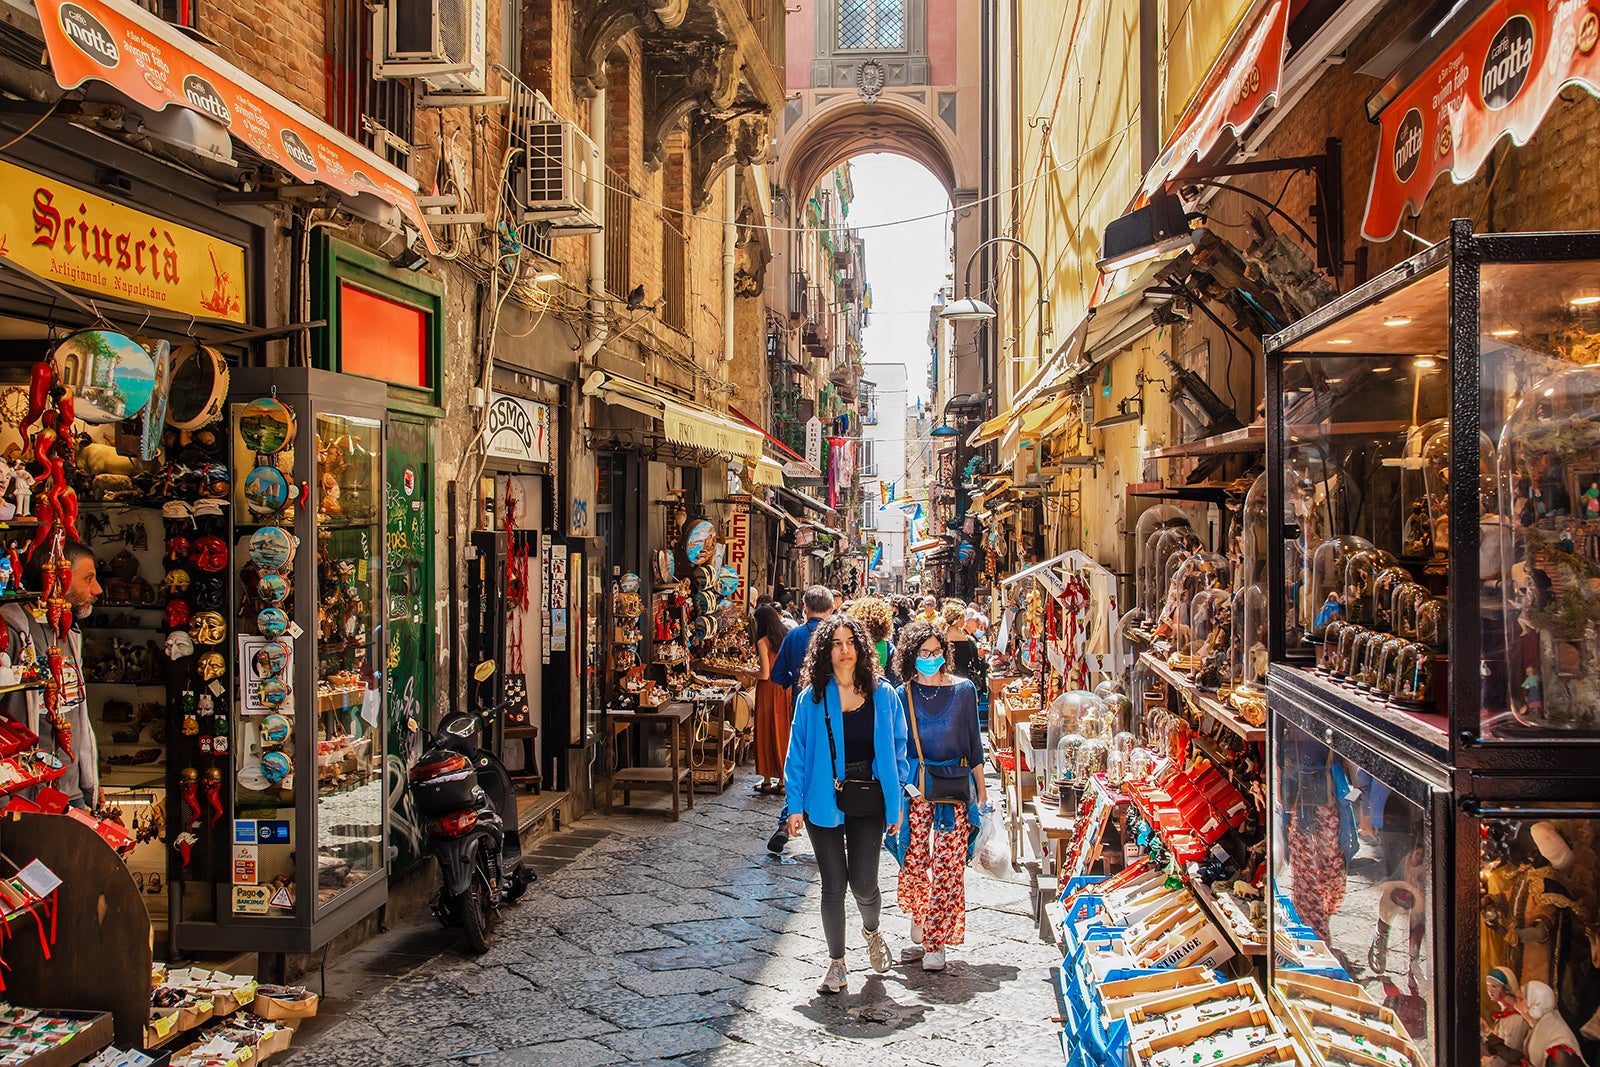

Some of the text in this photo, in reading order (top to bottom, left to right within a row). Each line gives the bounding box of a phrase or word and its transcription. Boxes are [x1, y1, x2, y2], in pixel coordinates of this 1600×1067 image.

[65, 17, 118, 60] motta
[1483, 36, 1532, 98] motta
[187, 89, 230, 120] motta
[284, 141, 315, 167] motta
[1396, 126, 1422, 171] motta
[32, 187, 180, 285] Sciuscià
[50, 257, 167, 301] Artigianato Napoletano
[489, 402, 532, 449] OSMOS
[732, 514, 746, 606] FERRIN
[238, 888, 256, 898] Pago
[1157, 937, 1201, 969] STORAGE
